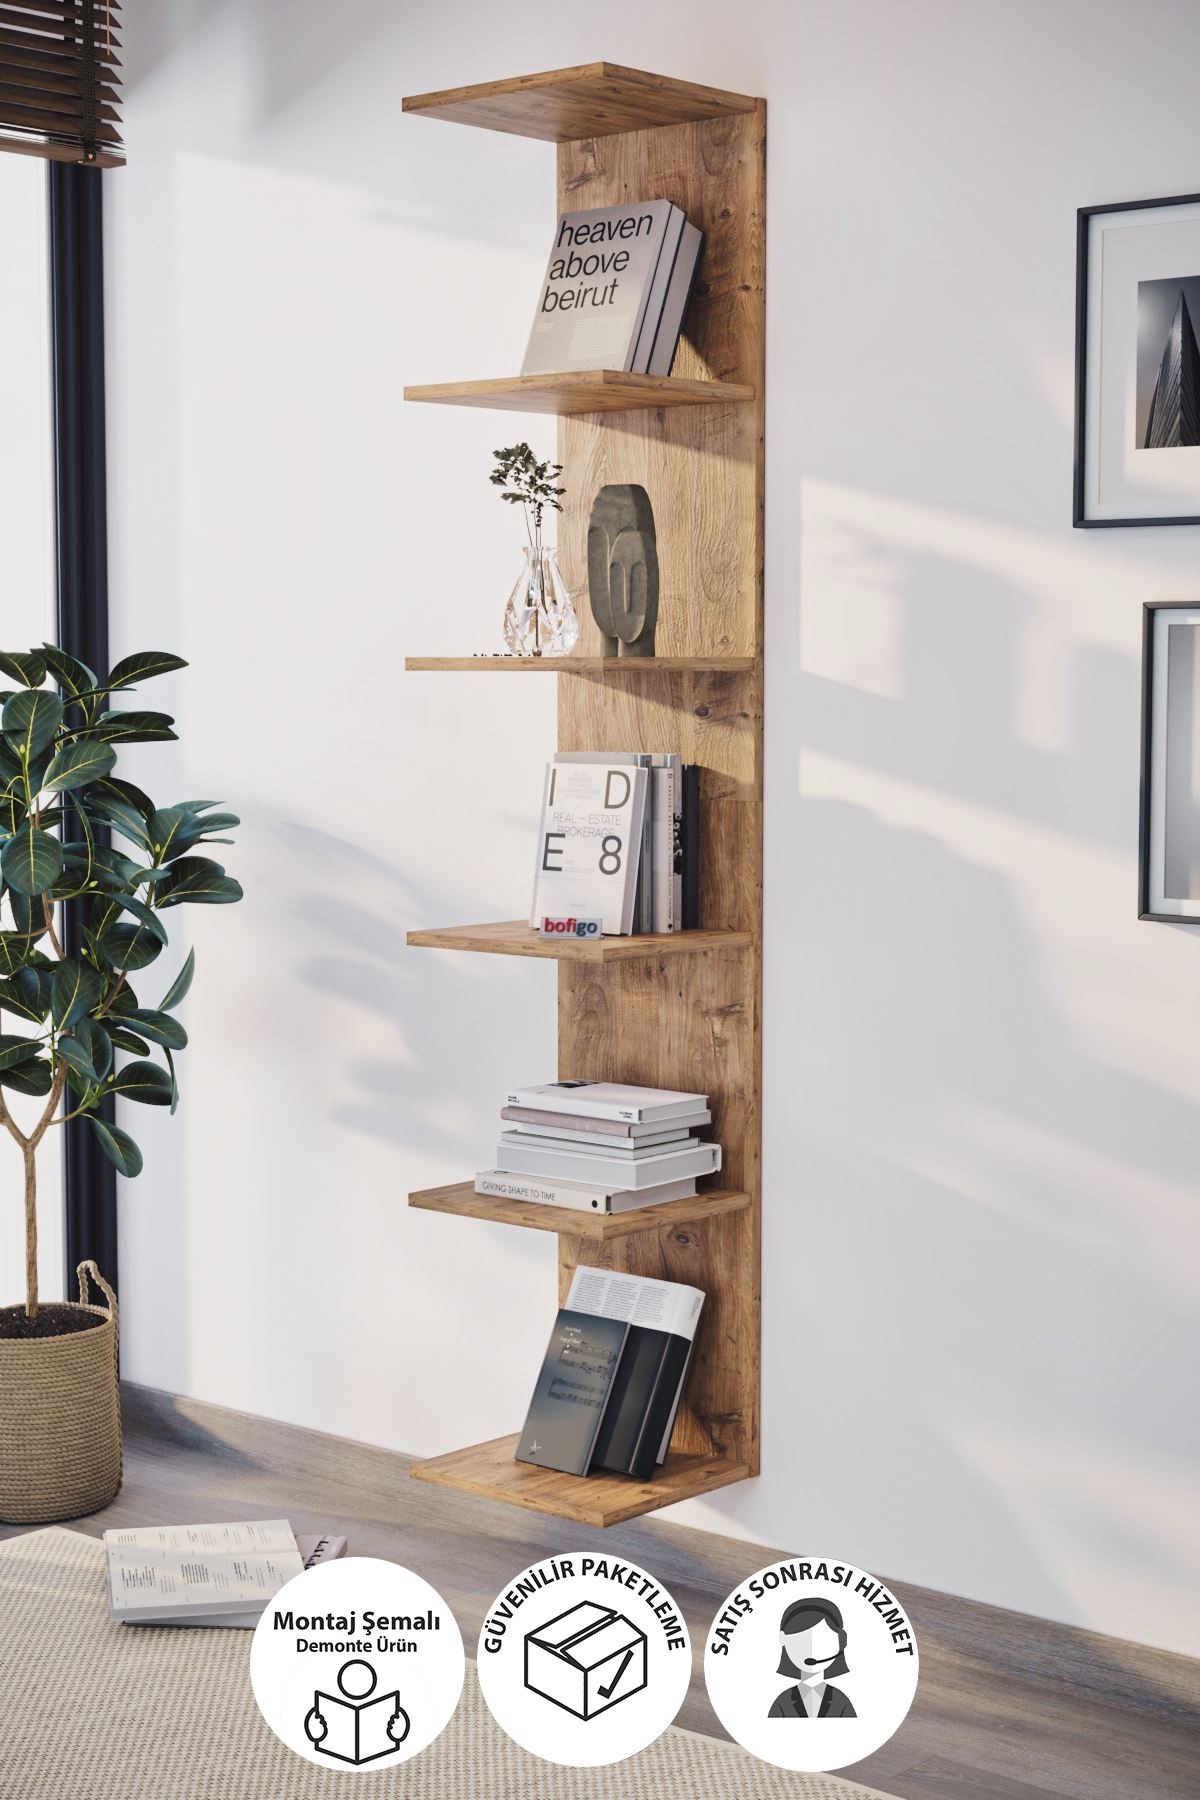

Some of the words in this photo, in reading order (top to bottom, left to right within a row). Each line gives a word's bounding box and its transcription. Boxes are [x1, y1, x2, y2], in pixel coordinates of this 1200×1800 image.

[557, 214, 653, 248] heaven
[549, 250, 630, 281] above
[541, 278, 619, 313] beirut
[604, 770, 631, 809] D
[553, 812, 576, 824] REAL
[588, 813, 622, 826] ESTATE
[557, 825, 615, 839] BROKERAGE
[542, 832, 566, 872] E
[599, 835, 622, 875] 8
[544, 917, 598, 937] bofigo
[482, 1181, 507, 1193] GIVING
[507, 1185, 529, 1197] SHAPE
[530, 1189, 540, 1199] TO
[541, 1191, 556, 1201] TIME
